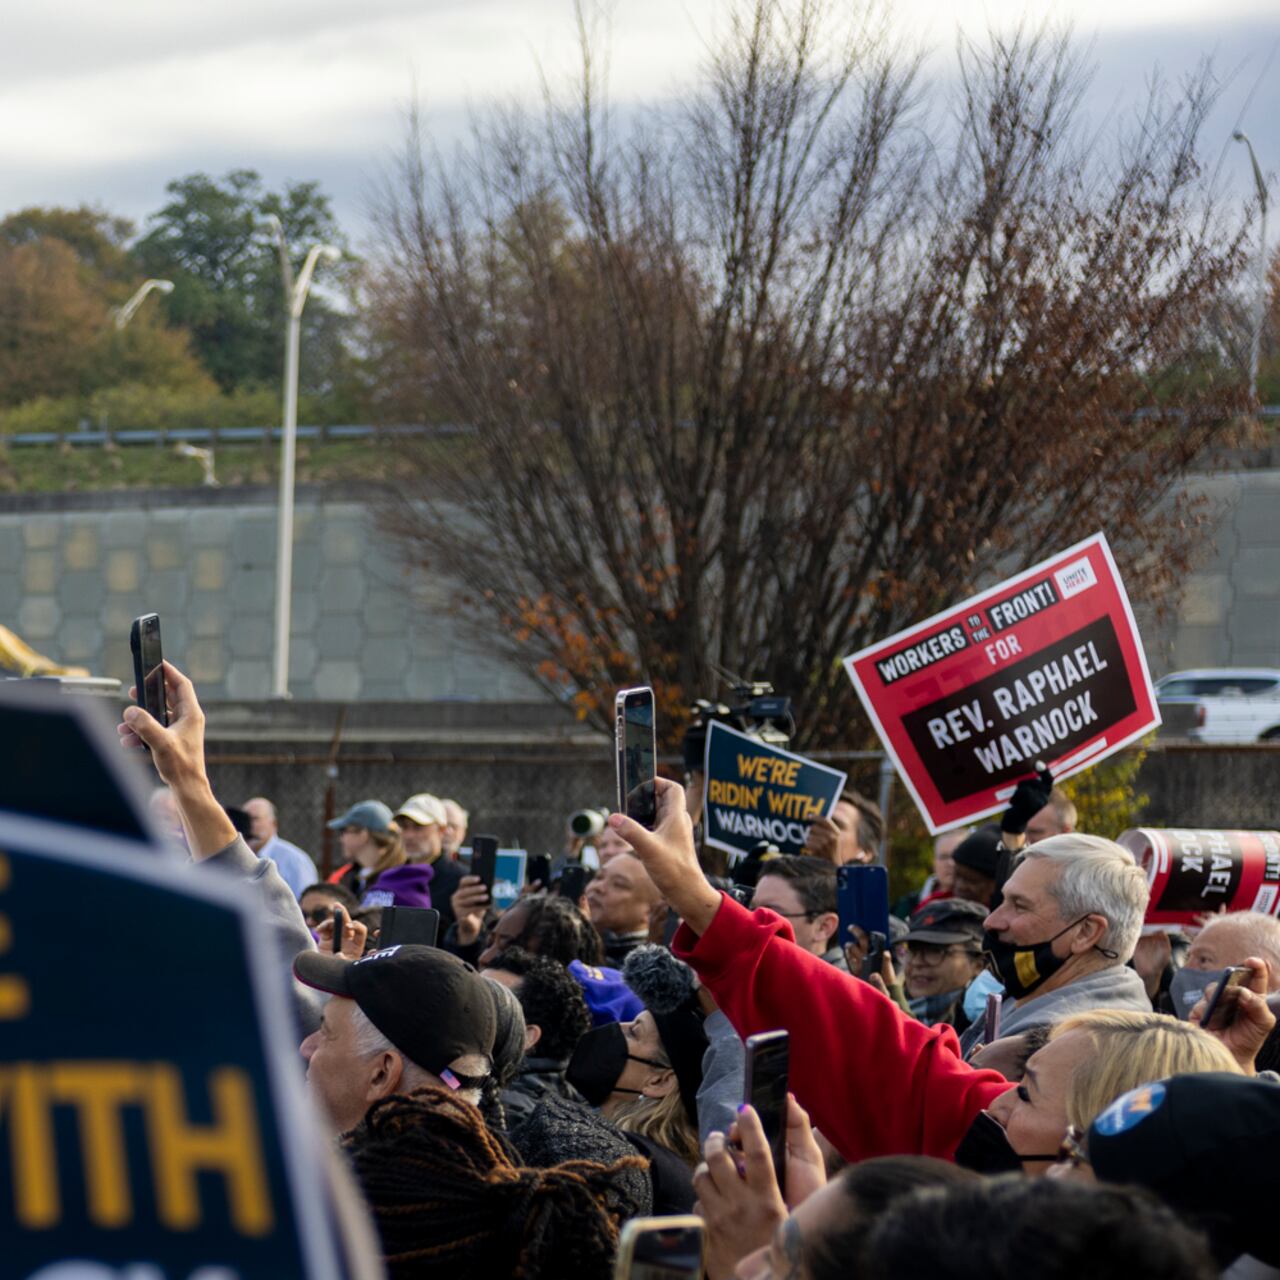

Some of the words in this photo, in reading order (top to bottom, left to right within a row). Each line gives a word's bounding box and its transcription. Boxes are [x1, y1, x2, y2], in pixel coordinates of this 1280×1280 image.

[878, 627, 967, 682] WORKERS
[990, 581, 1056, 630] FRONT!
[985, 633, 1023, 665] FOR
[927, 699, 994, 750] REV.
[992, 641, 1107, 720] RAPHAEL
[974, 690, 1098, 775] WARNOCK
[709, 779, 764, 810] RIDIN'
[767, 790, 826, 820] WITH
[737, 753, 802, 787] WE'RE
